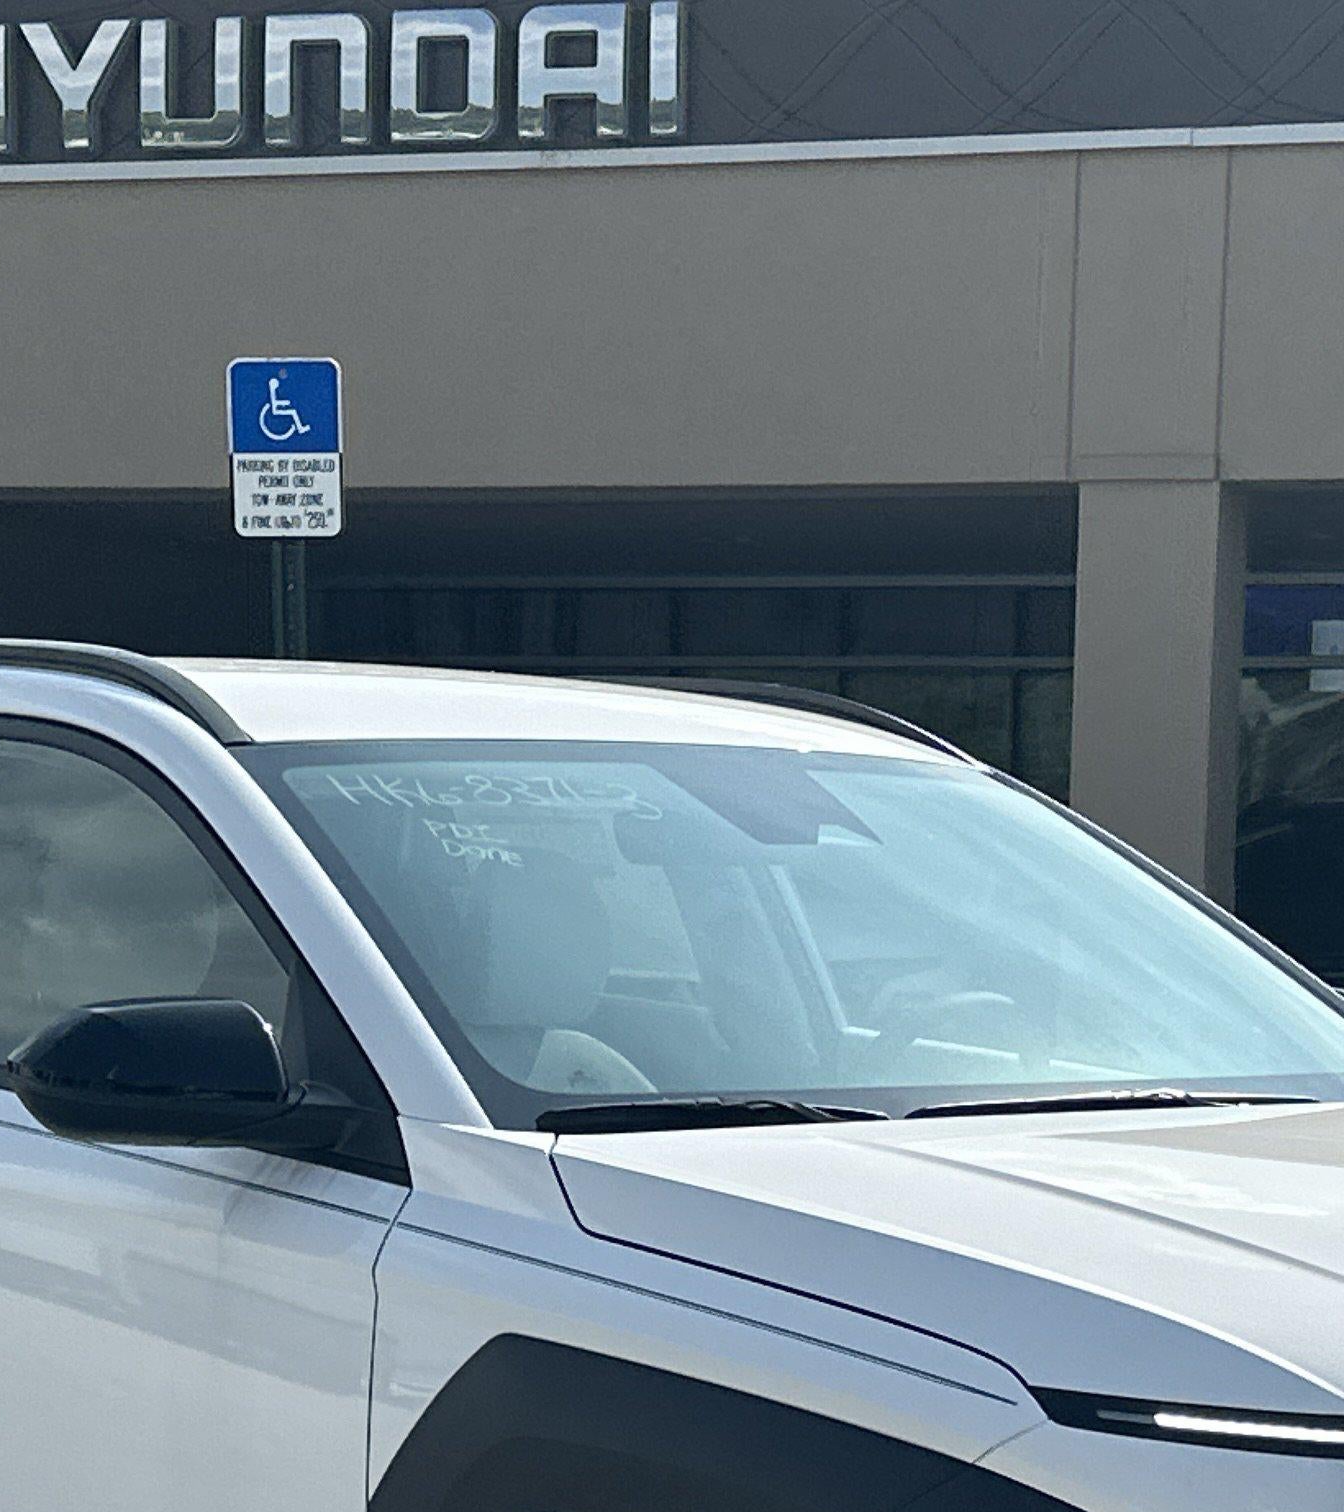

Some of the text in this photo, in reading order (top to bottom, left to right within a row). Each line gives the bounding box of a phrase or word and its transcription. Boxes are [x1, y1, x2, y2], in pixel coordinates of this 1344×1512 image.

[237, 459, 335, 473] PARKING BY DISABLED
